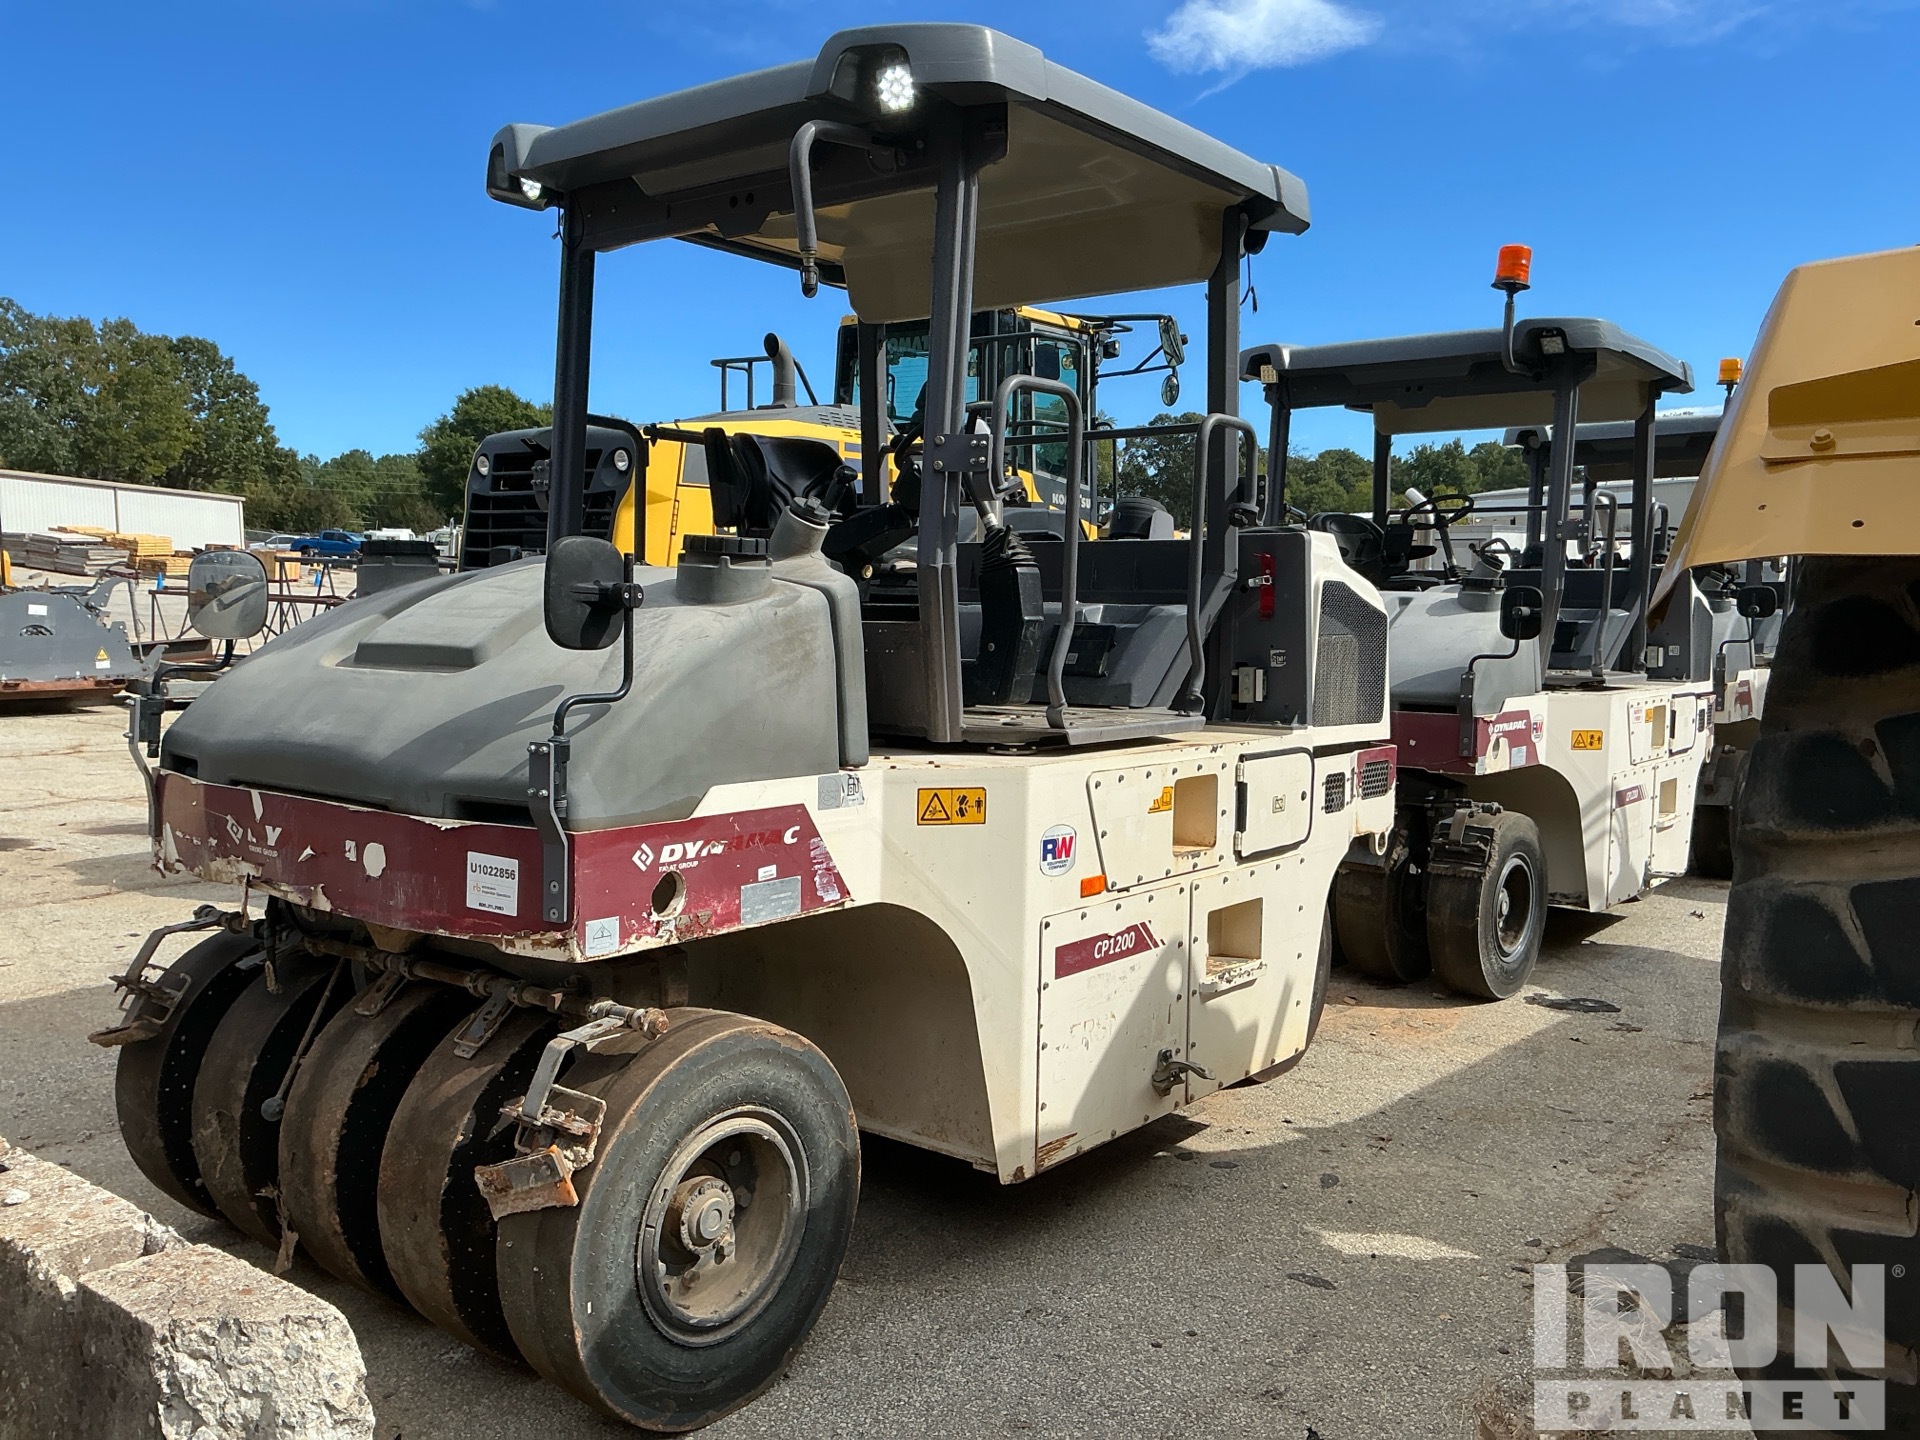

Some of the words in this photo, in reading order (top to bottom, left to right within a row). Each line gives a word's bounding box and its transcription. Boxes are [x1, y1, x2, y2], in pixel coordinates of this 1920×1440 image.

[1052, 493, 1091, 509] KOSU
[1493, 719, 1527, 733] DYNAPAC
[1042, 835, 1074, 862] RW
[470, 862, 516, 881] U1022856
[678, 861, 698, 870] GROUP
[1094, 931, 1136, 959] CP1200
